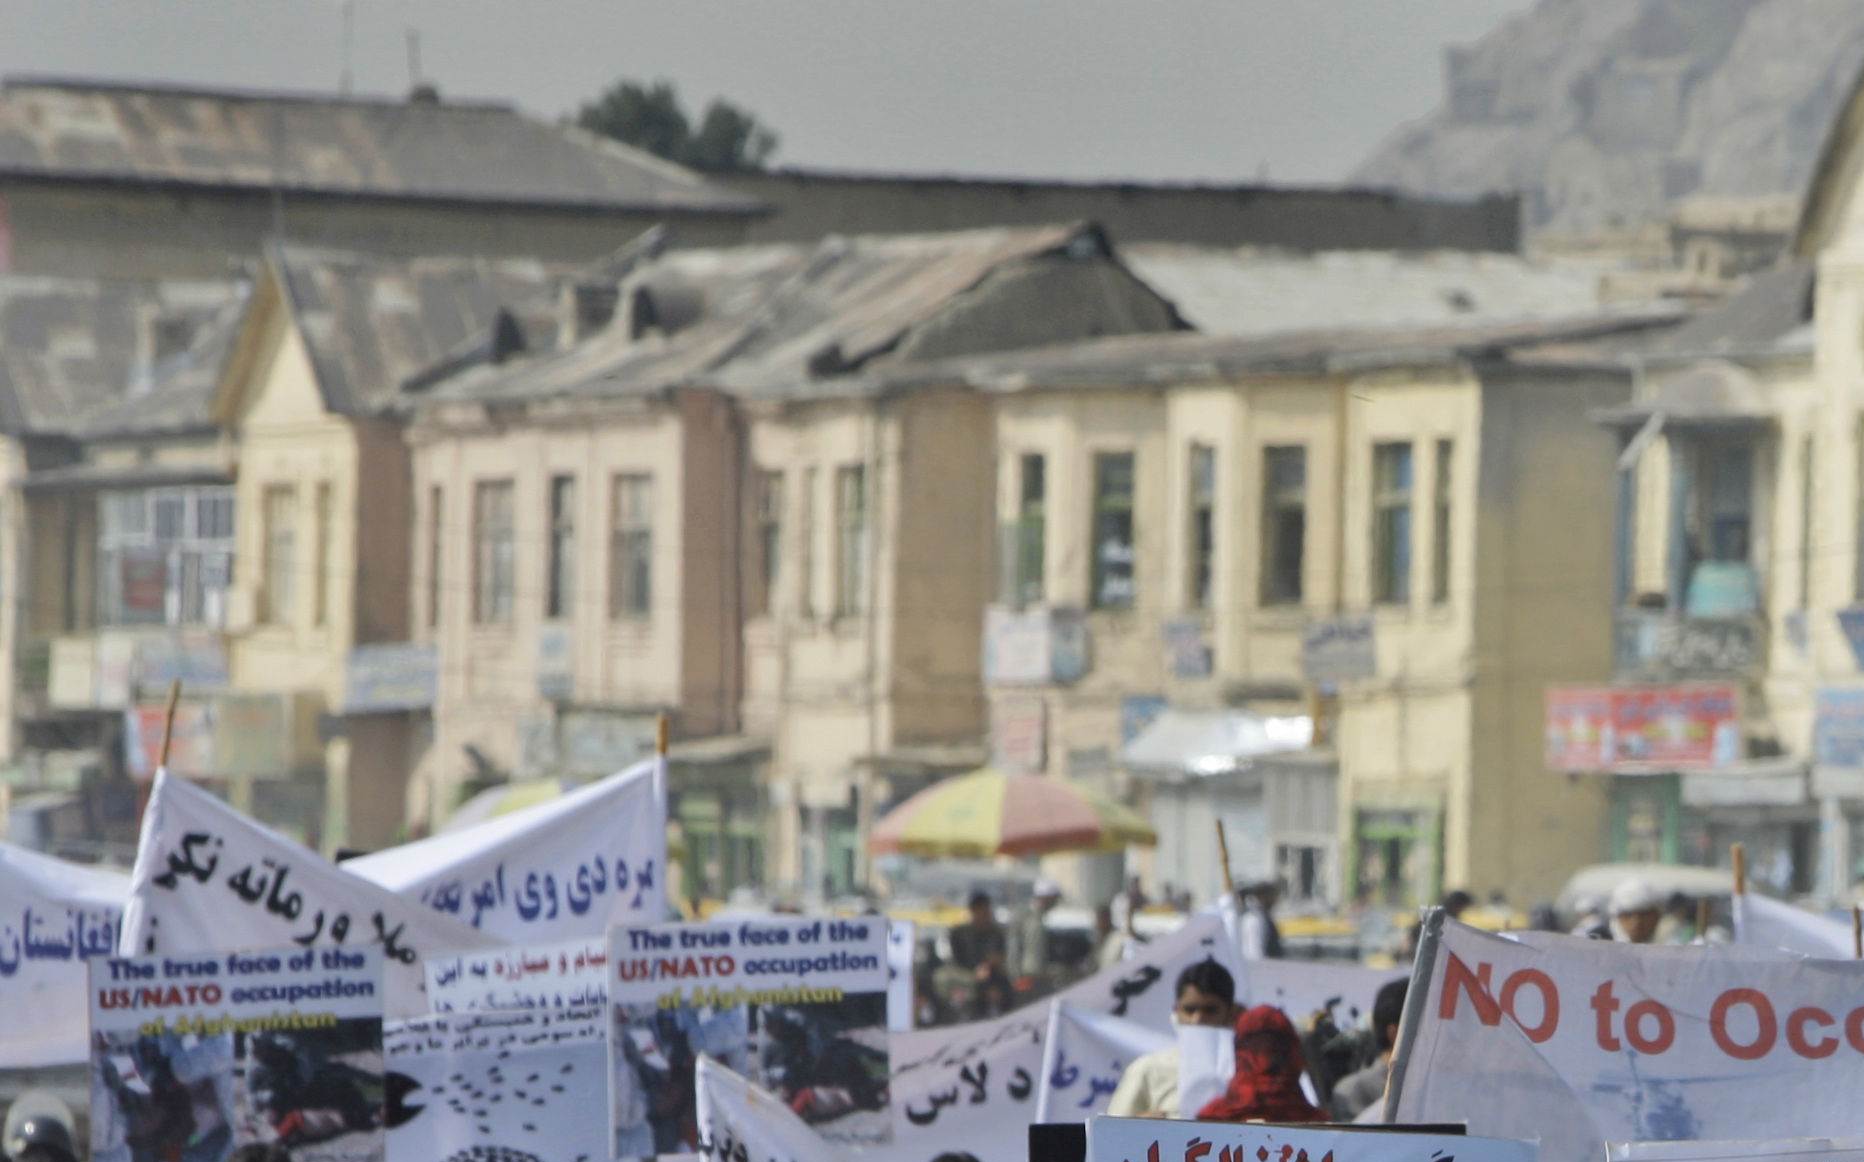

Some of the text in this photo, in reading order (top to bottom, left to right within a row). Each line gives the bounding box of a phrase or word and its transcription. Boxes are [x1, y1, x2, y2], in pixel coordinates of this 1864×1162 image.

[628, 921, 869, 950] The true face of the
[107, 949, 365, 981] The true face of the
[619, 954, 878, 981] US/NATO occupation
[98, 980, 375, 1010] US/NATO occupation
[658, 986, 844, 1011] of Afghanistan
[1437, 951, 1561, 1044] NO
[1590, 979, 1676, 1056] to
